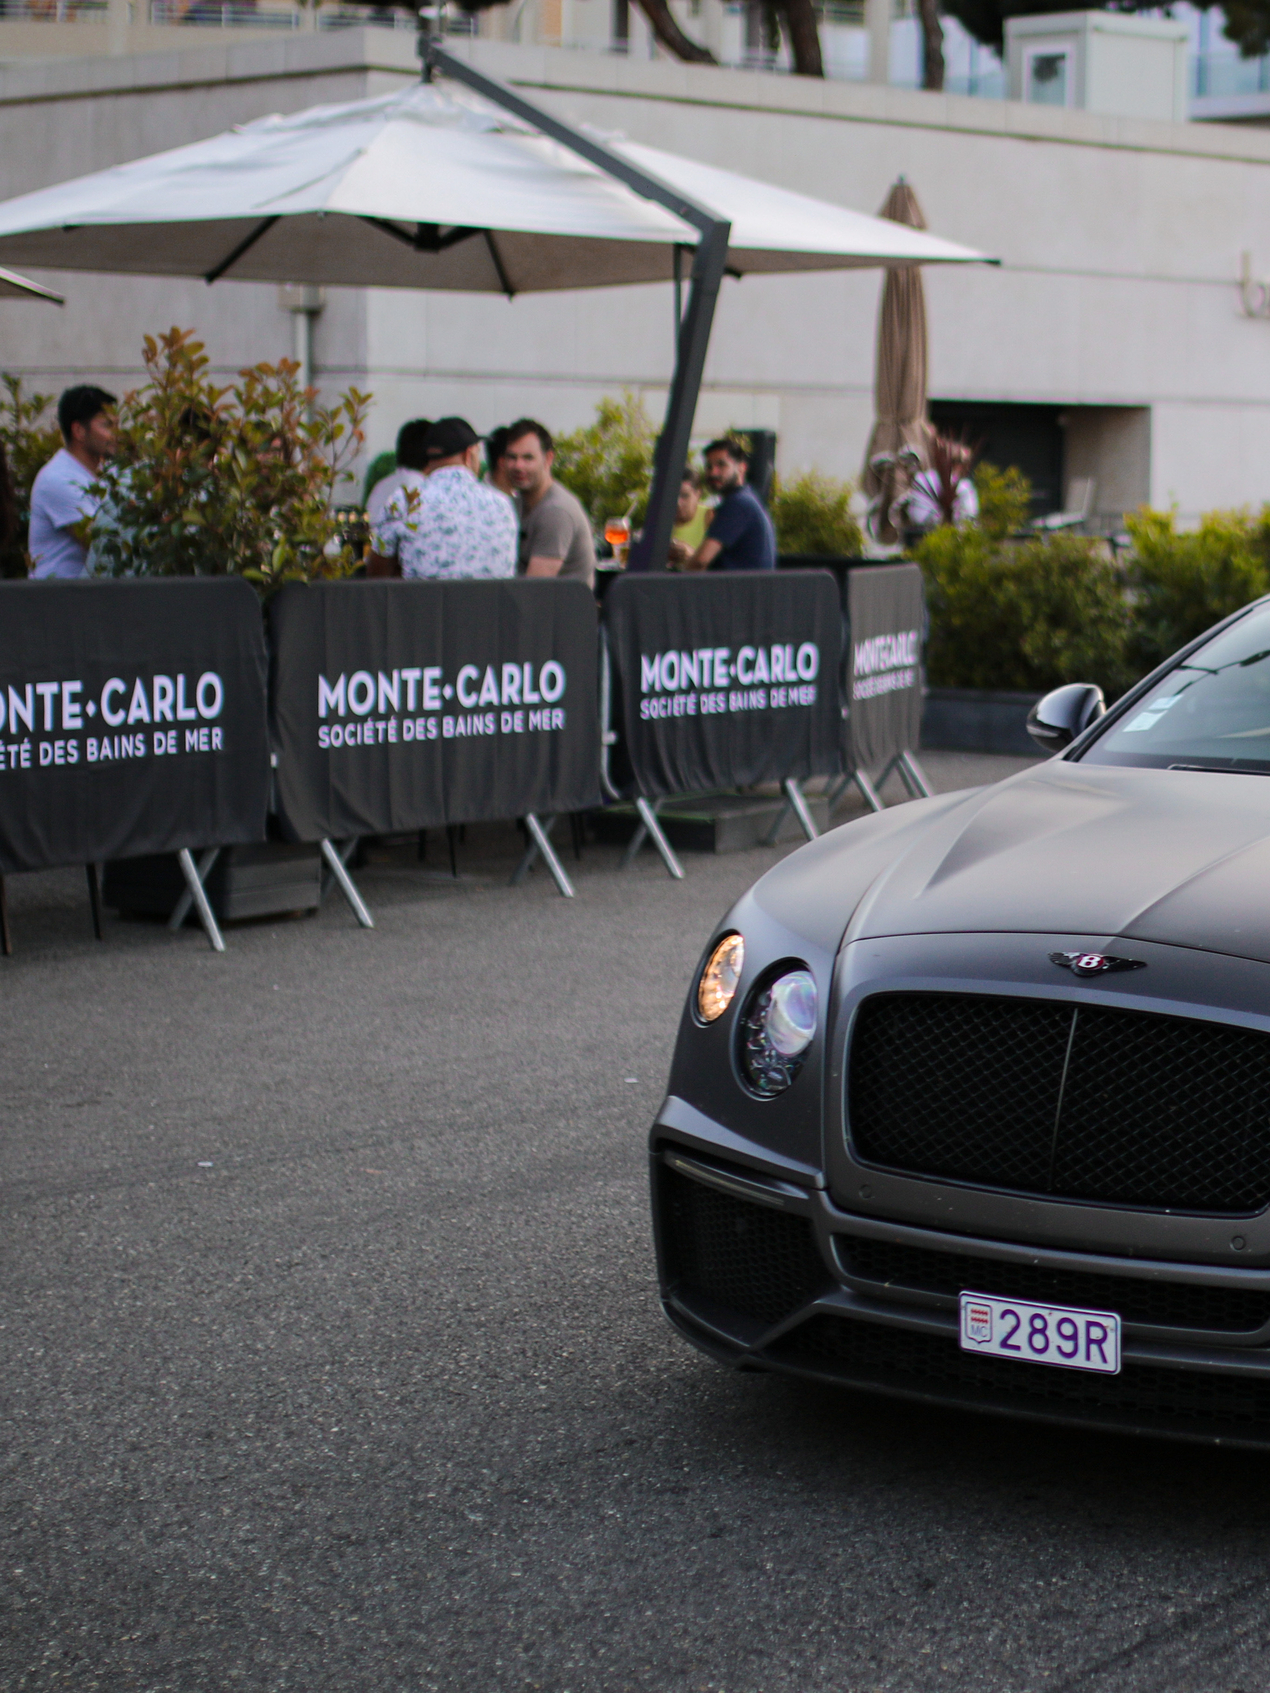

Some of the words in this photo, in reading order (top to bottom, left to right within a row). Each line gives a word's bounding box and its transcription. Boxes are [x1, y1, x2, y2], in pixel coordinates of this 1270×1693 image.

[700, 692, 726, 715] DES
[770, 686, 787, 708] DE
[39, 739, 78, 766] DES
[86, 732, 146, 762] BAINS
[153, 729, 177, 755] DE
[185, 726, 223, 753] MER
[318, 715, 398, 748] SOCIÉTÉ
[403, 717, 438, 741] DES
[442, 712, 495, 738] BAINS
[500, 710, 524, 733] DE
[528, 708, 565, 731] MER
[1078, 955, 1101, 968] B
[970, 1325, 988, 1339] MC
[999, 1308, 1108, 1364] 289R
